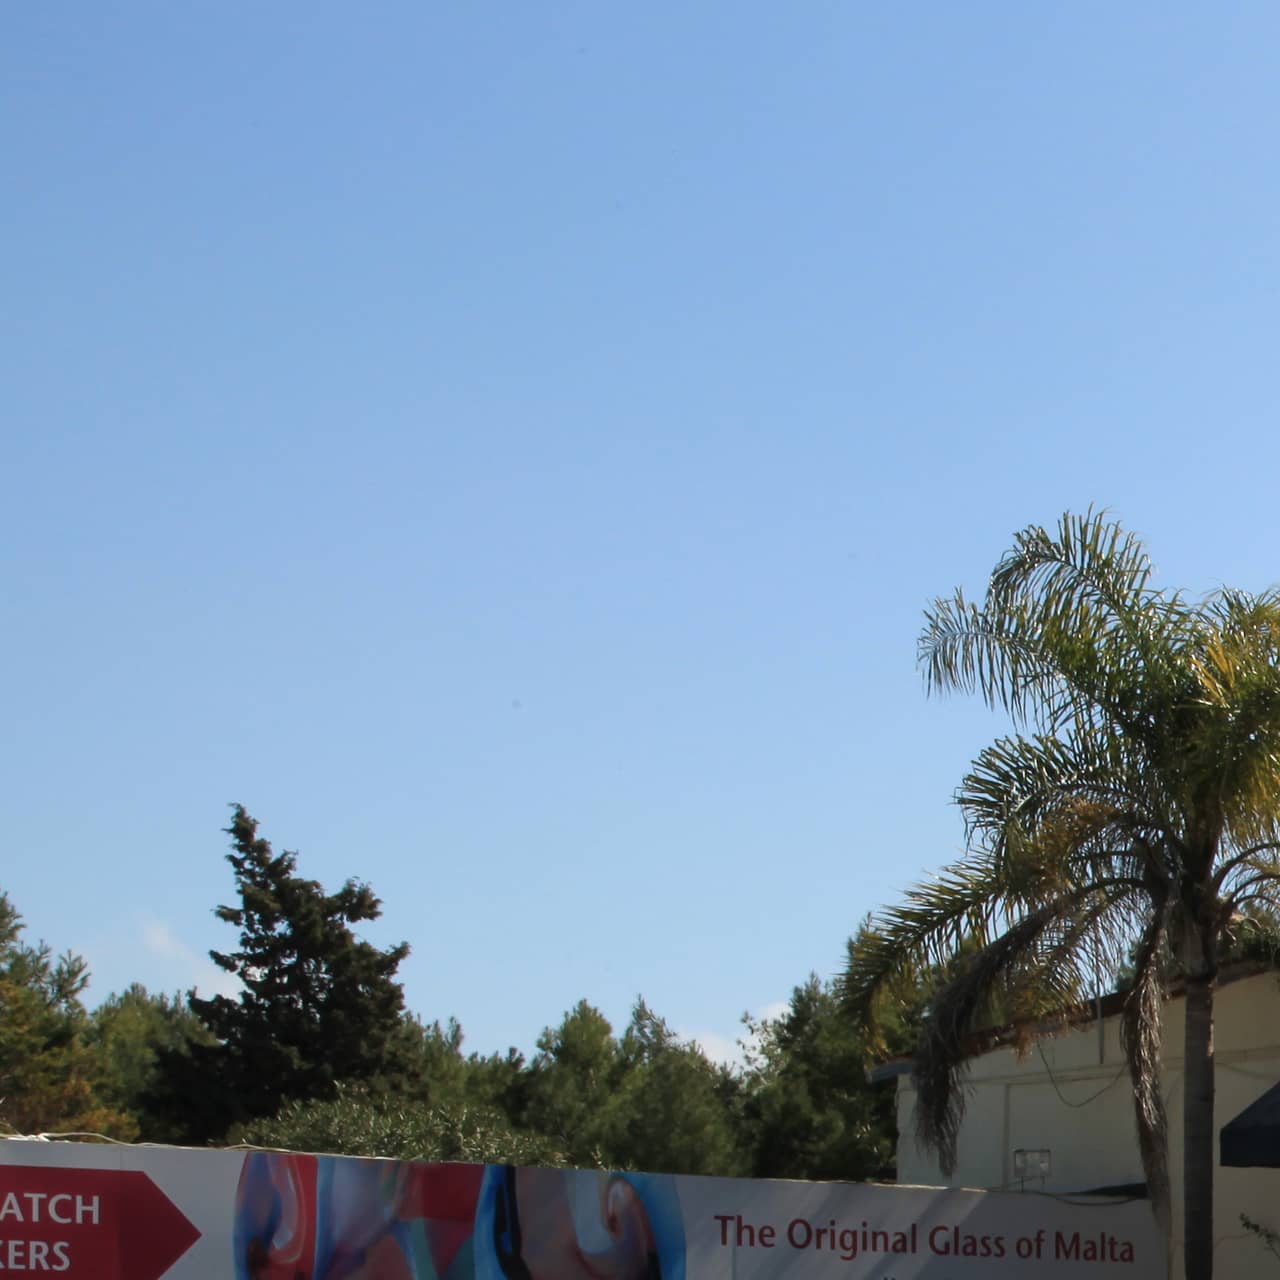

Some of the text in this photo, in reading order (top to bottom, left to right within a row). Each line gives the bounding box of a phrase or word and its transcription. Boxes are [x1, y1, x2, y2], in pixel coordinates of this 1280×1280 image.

[0, 1192, 99, 1224] ATCH
[0, 1239, 70, 1271] ERS
[714, 1215, 1135, 1263] The Original Glass of Malta
